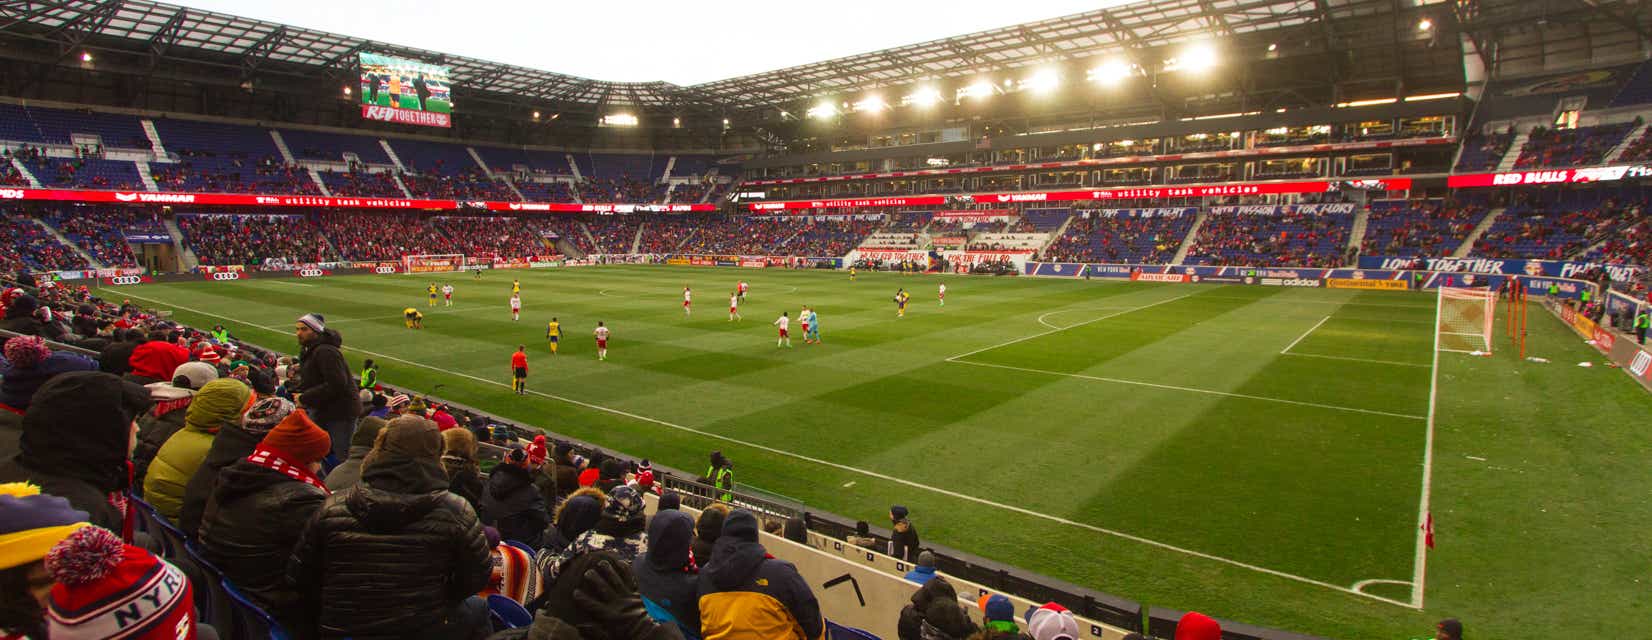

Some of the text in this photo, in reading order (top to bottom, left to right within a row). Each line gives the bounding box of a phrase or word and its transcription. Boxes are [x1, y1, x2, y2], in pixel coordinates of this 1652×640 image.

[367, 106, 395, 121] RED
[1493, 173, 1522, 185] RED
[1524, 170, 1568, 183] BULLS
[1011, 193, 1047, 201] YANMAR
[1117, 188, 1160, 198] utility
[1168, 187, 1193, 196] task
[1201, 185, 1258, 195] vehicles
[139, 193, 195, 203] YANMAR
[286, 198, 330, 206] utility
[1425, 257, 1505, 274] TOGETHER
[1283, 278, 1320, 287] adidas
